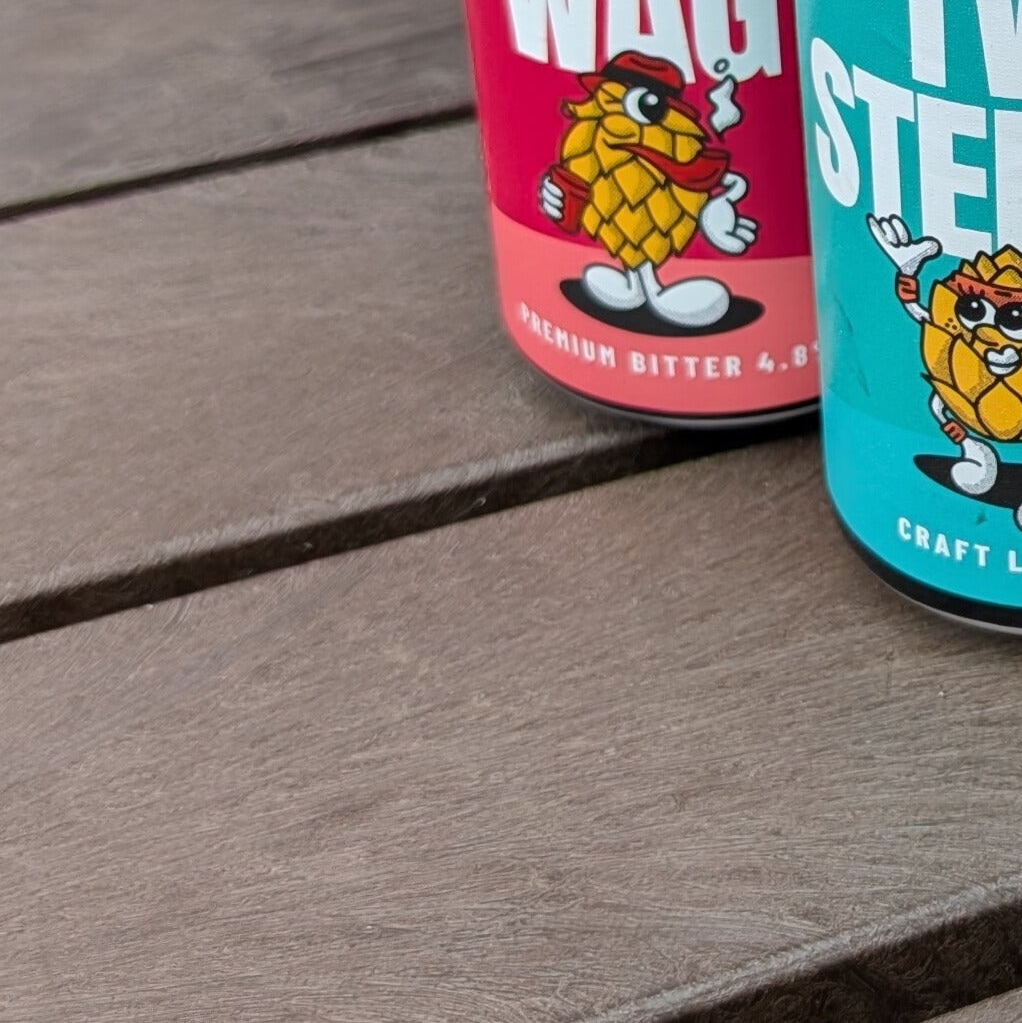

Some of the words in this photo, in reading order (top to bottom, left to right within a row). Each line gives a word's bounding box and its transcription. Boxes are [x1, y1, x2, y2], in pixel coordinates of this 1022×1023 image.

[519, 300, 617, 368] PREMIUM
[630, 350, 742, 378] BITTER
[757, 340, 818, 373] 4.8
[896, 516, 991, 568] CRAFT
